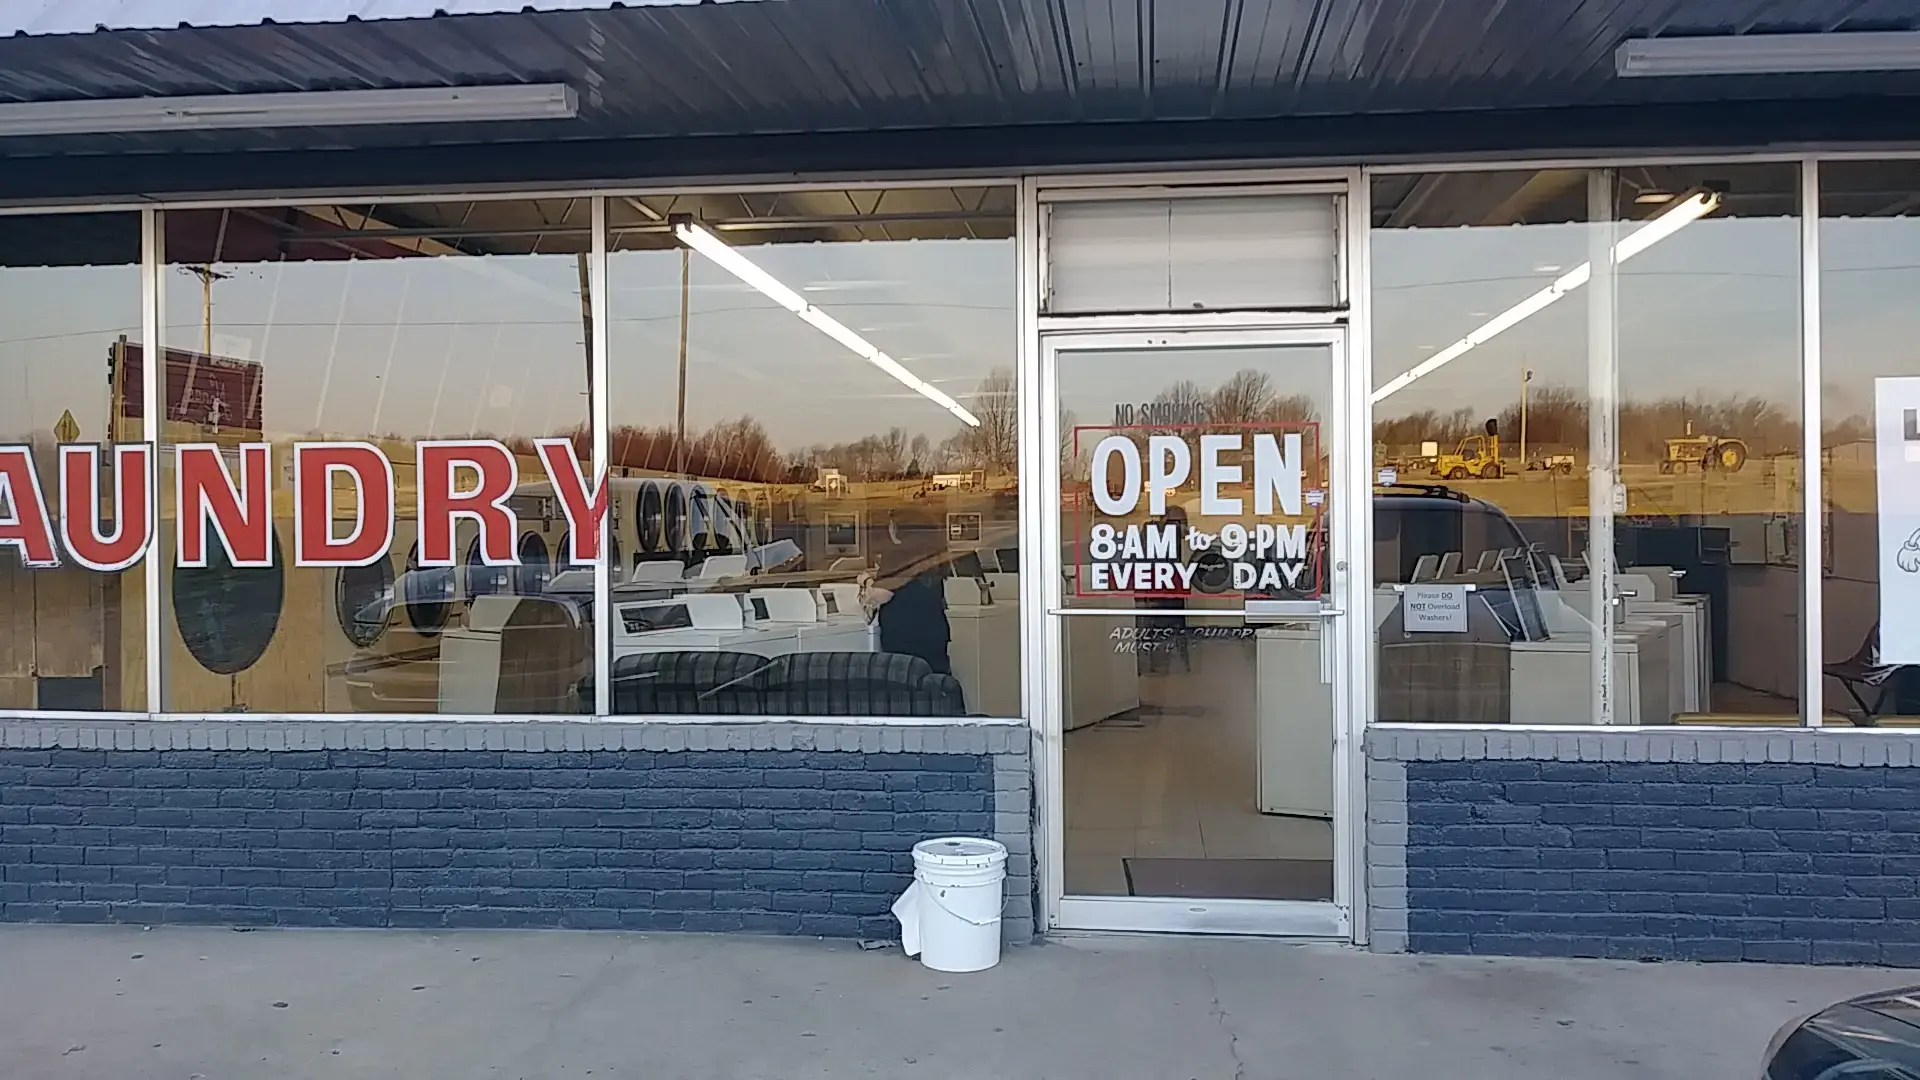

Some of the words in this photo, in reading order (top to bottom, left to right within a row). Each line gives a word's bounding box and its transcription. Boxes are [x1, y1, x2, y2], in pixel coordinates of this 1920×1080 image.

[1115, 403, 1134, 426] NO
[1140, 402, 1205, 426] SMOKING
[1091, 433, 1302, 516] OPEN
[1089, 523, 1178, 559] 8:AM
[1184, 525, 1217, 551] to
[1220, 523, 1306, 559] 9:PM
[1091, 562, 1198, 590] EVERY
[1232, 562, 1306, 590] DAY
[1441, 592, 1453, 600] DO
[1410, 603, 1426, 611] NOT
[1109, 627, 1174, 641] ADULTS
[1113, 642, 1160, 654] MUST
